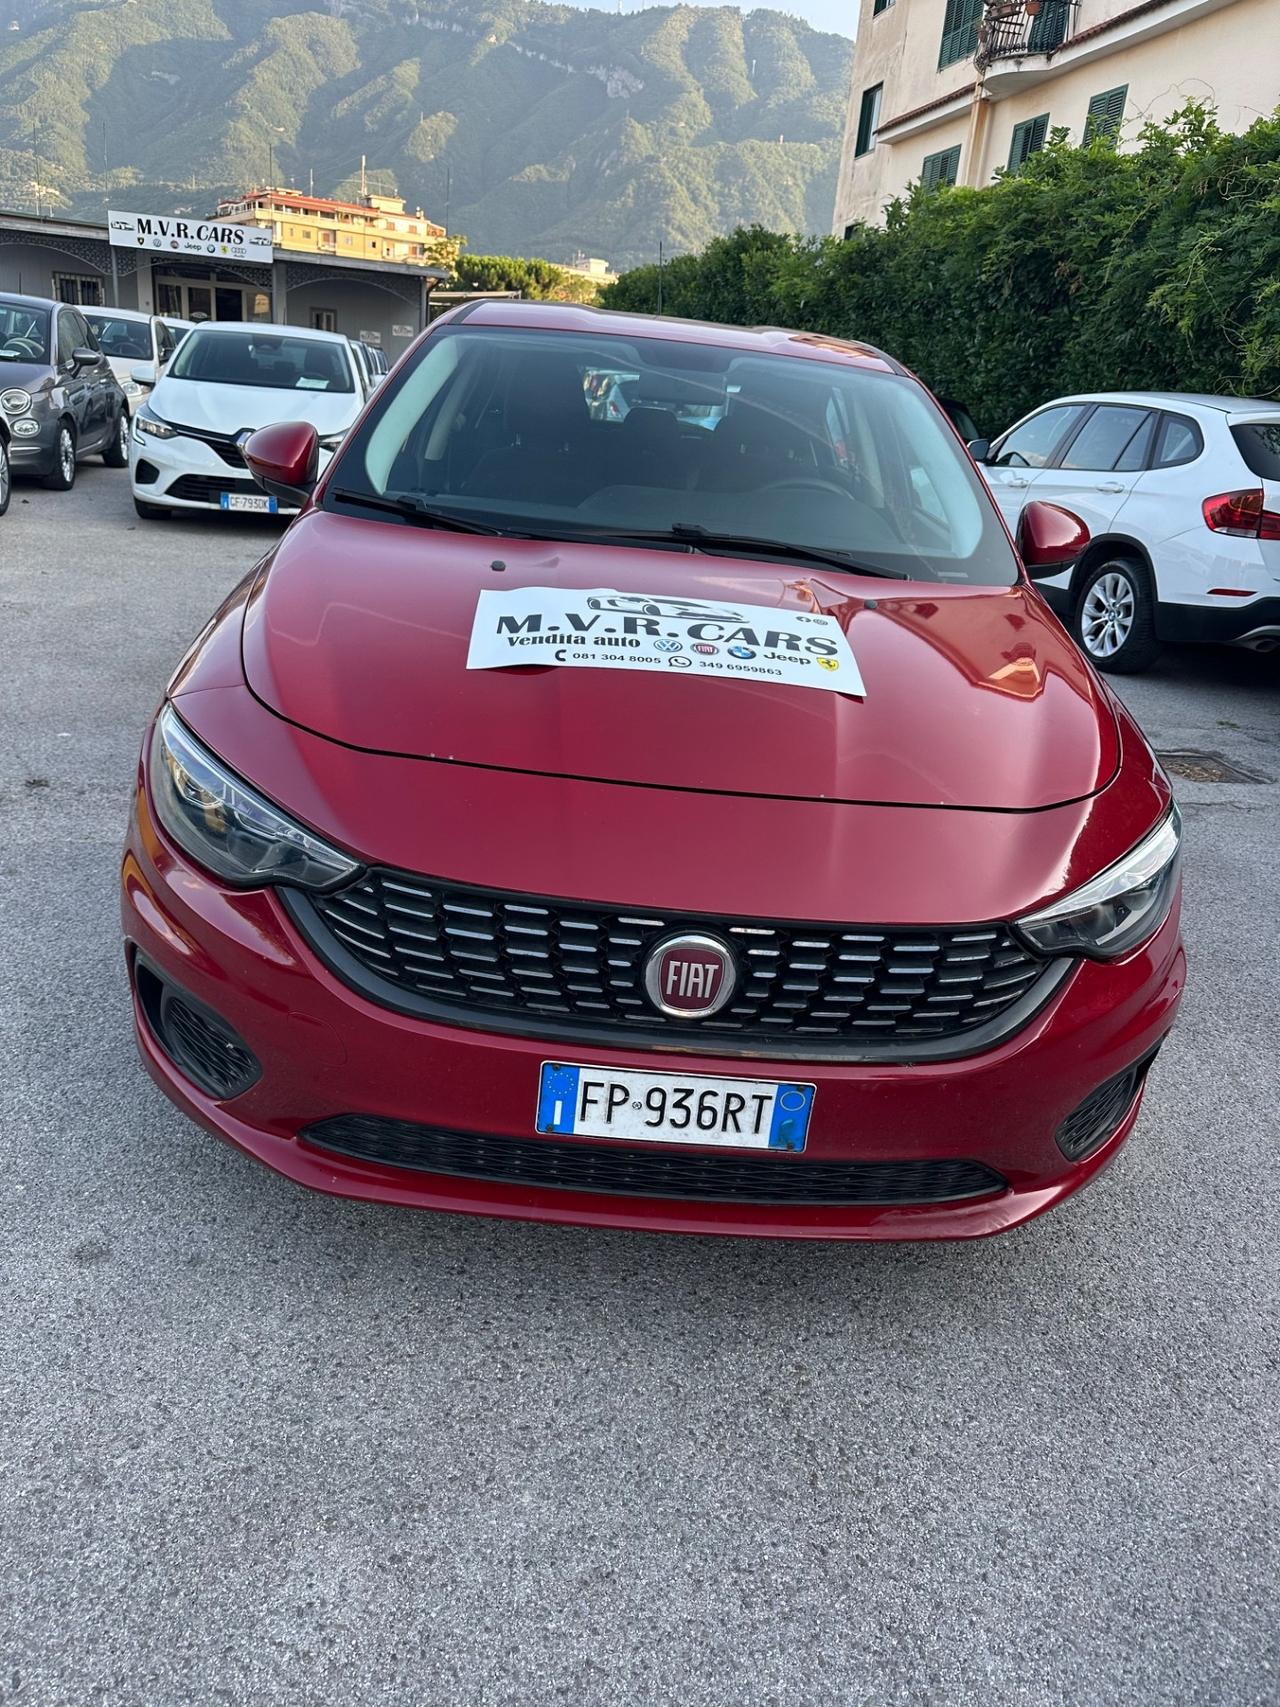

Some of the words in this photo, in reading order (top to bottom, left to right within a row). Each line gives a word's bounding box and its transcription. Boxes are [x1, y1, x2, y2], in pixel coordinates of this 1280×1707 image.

[184, 242, 202, 251] Jeep
[507, 633, 586, 647] vendita
[593, 636, 641, 648] auto
[572, 652, 596, 660] 081
[601, 653, 625, 661] 304
[629, 655, 661, 664] 8005
[763, 652, 811, 665] Jeep
[699, 661, 723, 669] 349
[726, 663, 783, 676] 6959863
[666, 960, 719, 998] FIAT
